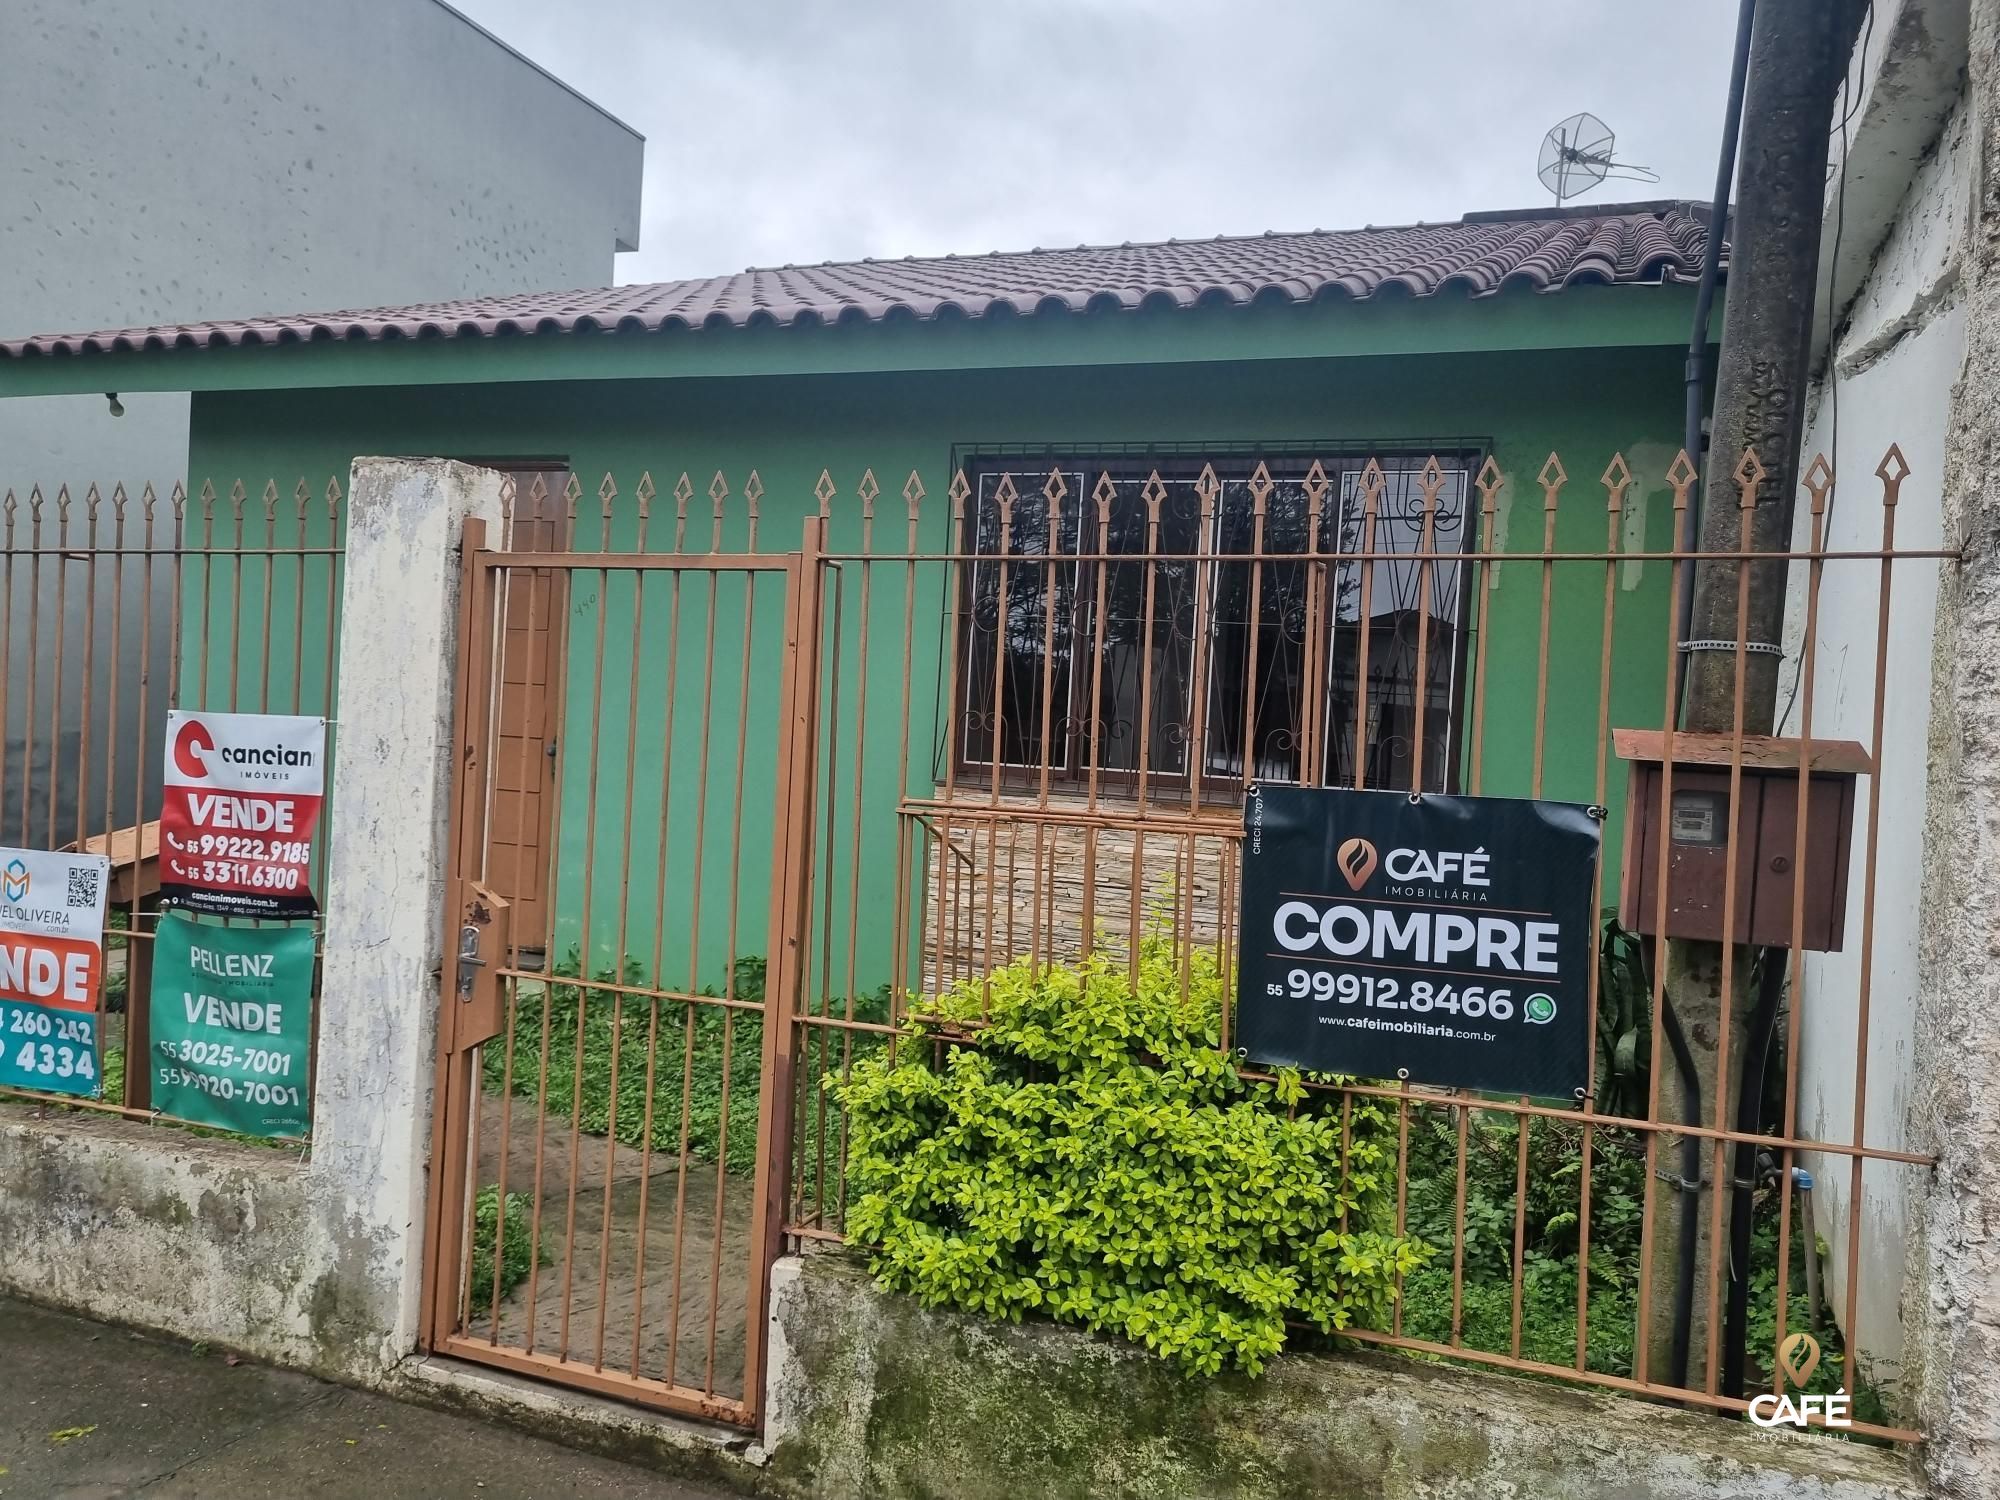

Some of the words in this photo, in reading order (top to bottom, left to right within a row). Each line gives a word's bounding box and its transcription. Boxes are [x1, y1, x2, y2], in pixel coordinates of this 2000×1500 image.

[222, 744, 312, 767] cancian
[240, 771, 290, 780] IMÓVEIS
[187, 793, 294, 833] VENDE
[1254, 797, 1264, 827] 24.707
[187, 840, 199, 854] 55
[200, 834, 310, 865] 99222.9185
[1253, 828, 1261, 855] CRECI
[188, 867, 199, 880] 55
[202, 860, 299, 890] 3311.6300
[1384, 846, 1491, 887] CAFÉ
[1385, 886, 1488, 902] IMOBILIÁRIA
[16, 907, 70, 925] OLIVEIRA
[1273, 901, 1560, 974] COMPRE
[190, 945, 275, 978] PELLENZ
[1266, 983, 1284, 996] 55
[1286, 968, 1514, 1021] 99912.8466
[10, 1009, 52, 1037] 260
[55, 1018, 93, 1045] 242
[183, 992, 283, 1035] VENDE
[1318, 1015, 1497, 1042] www.cafeimobiliaria.com.br
[16, 1041, 95, 1080] 4334
[160, 1040, 177, 1058] 55
[179, 1039, 291, 1076] 3025-7001
[160, 1068, 180, 1085] 55
[180, 1067, 299, 1106] 99920-7001
